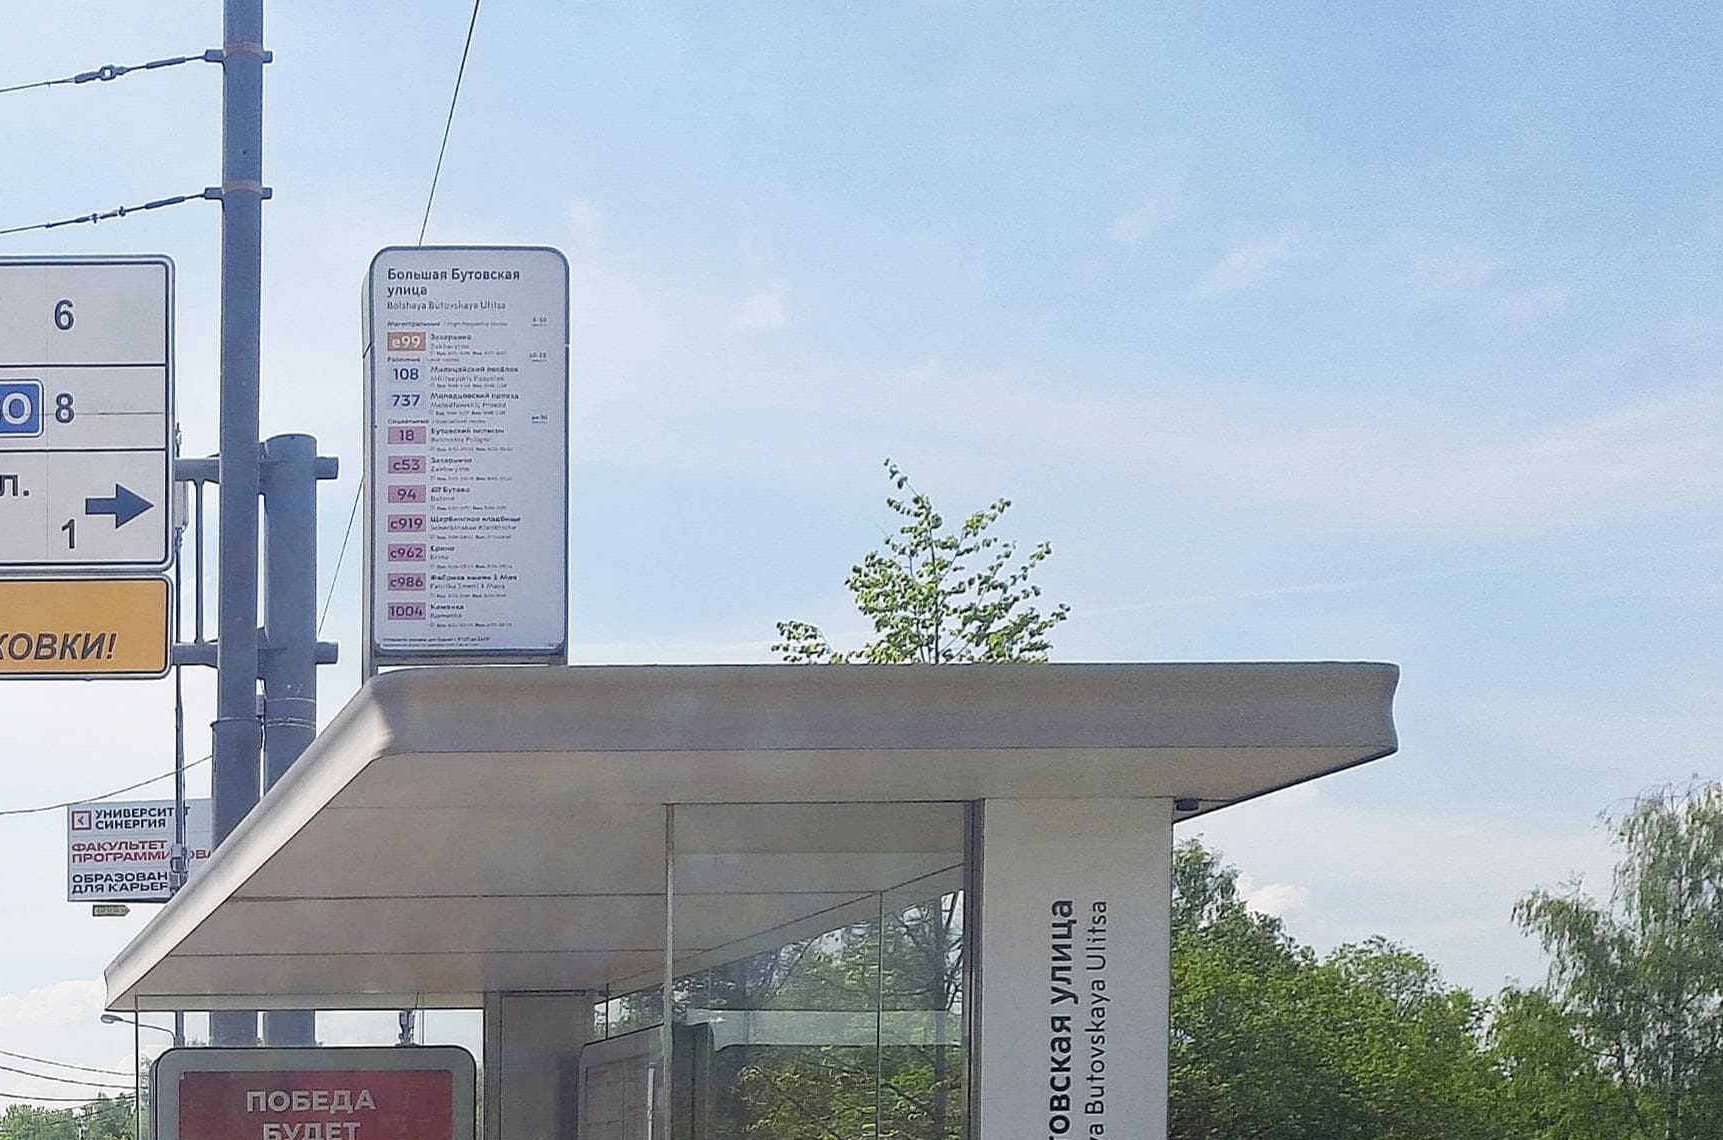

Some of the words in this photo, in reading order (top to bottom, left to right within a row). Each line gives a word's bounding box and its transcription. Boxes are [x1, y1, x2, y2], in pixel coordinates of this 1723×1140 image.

[387, 267, 447, 281] Большая
[451, 267, 520, 283] Бутовская
[387, 285, 427, 298] улица
[53, 299, 75, 331] 6
[391, 334, 421, 349] e99
[392, 367, 419, 381] 108
[391, 394, 421, 407] 737
[53, 391, 76, 425] 8
[399, 429, 415, 442] 18
[392, 459, 421, 472] c53
[396, 488, 417, 500] 94
[390, 517, 424, 530] c919
[60, 518, 77, 549] 1
[390, 547, 424, 559] c962
[390, 576, 424, 588] c986
[390, 605, 424, 617] 1004
[95, 806, 191, 820] УНИВЕРСИТТ
[95, 818, 167, 831] СИНЕРГИЯ
[71, 840, 168, 852] ФАКУЛЬТЕТ
[72, 871, 168, 884] ОБРАЗОВАН
[72, 883, 105, 895] ДЛЯ
[108, 881, 169, 893] КАРЬЕР
[1086, 900, 1108, 971] Ulitsa
[1050, 899, 1079, 1005] улица
[1084, 979, 1110, 1116] Butovskaya
[246, 1089, 377, 1113] ПОБЕДА
